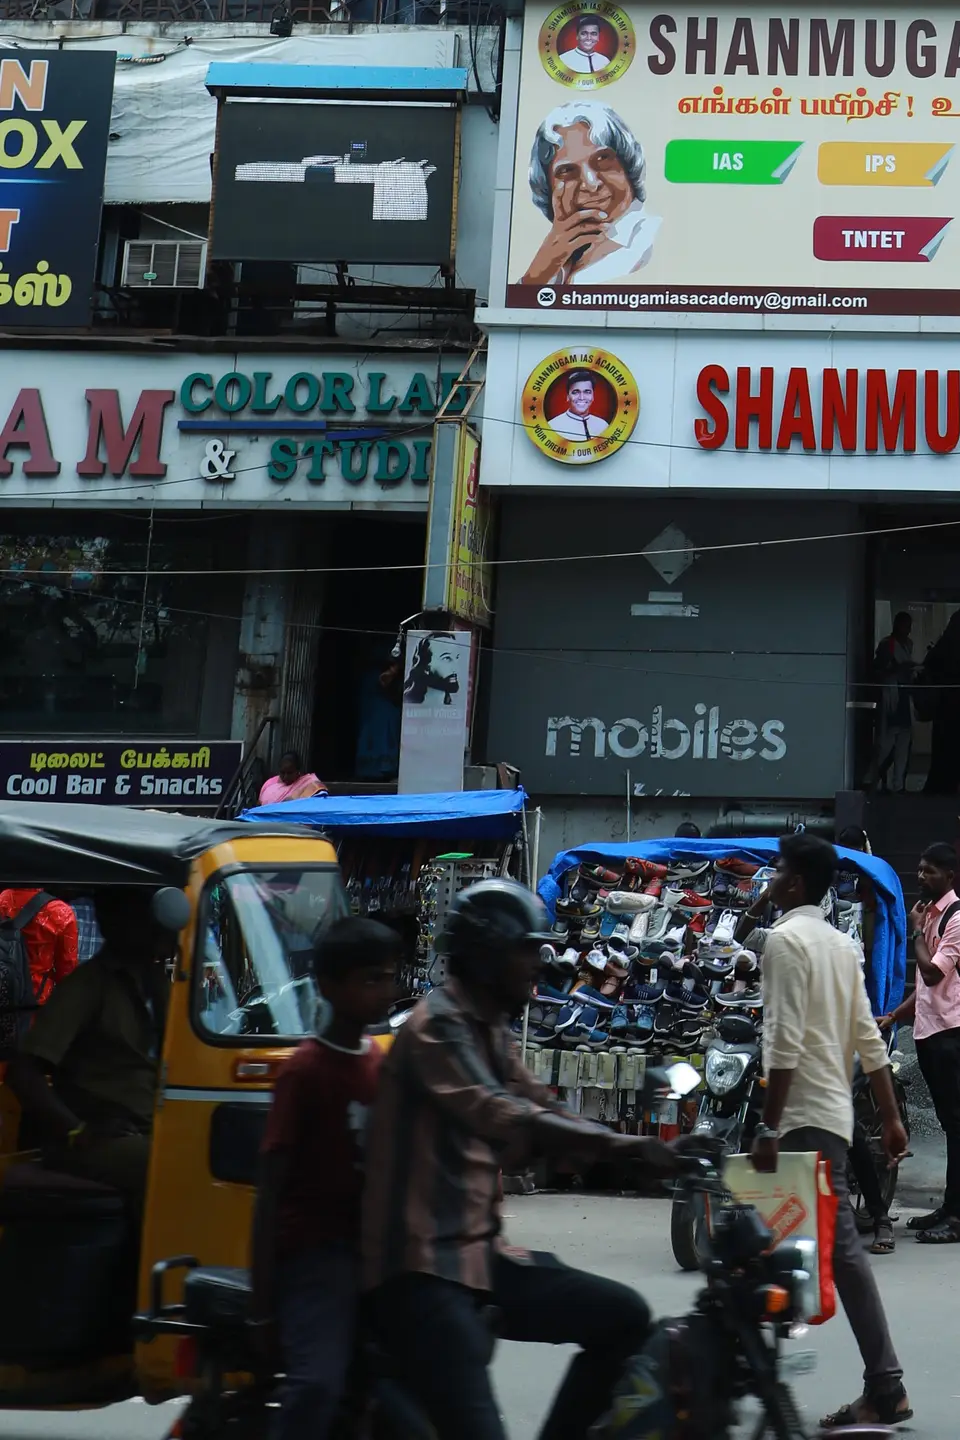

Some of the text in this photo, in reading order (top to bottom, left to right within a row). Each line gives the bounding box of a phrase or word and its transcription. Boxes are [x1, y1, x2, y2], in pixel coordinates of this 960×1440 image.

[549, 2, 588, 31] SHANMUGAM
[603, 6, 628, 32] ACADEMY
[677, 86, 792, 115] எங்கள்
[799, 87, 900, 122] பயிற்சி
[713, 153, 744, 171] IAS
[865, 155, 897, 173] IPS
[842, 230, 905, 249] TNTET
[561, 290, 869, 310] shanmugamiasacademy@gmail.com
[532, 354, 628, 392] SHANMUGAM IAS ACADEMY
[180, 372, 356, 413] COLOR
[200, 439, 235, 480] &
[577, 448, 592, 457] OUR
[545, 702, 788, 761] mobiles
[30, 747, 211, 772] டிலைட் பேக்கரி
[6, 774, 223, 795] Cool Bar & Snacks
